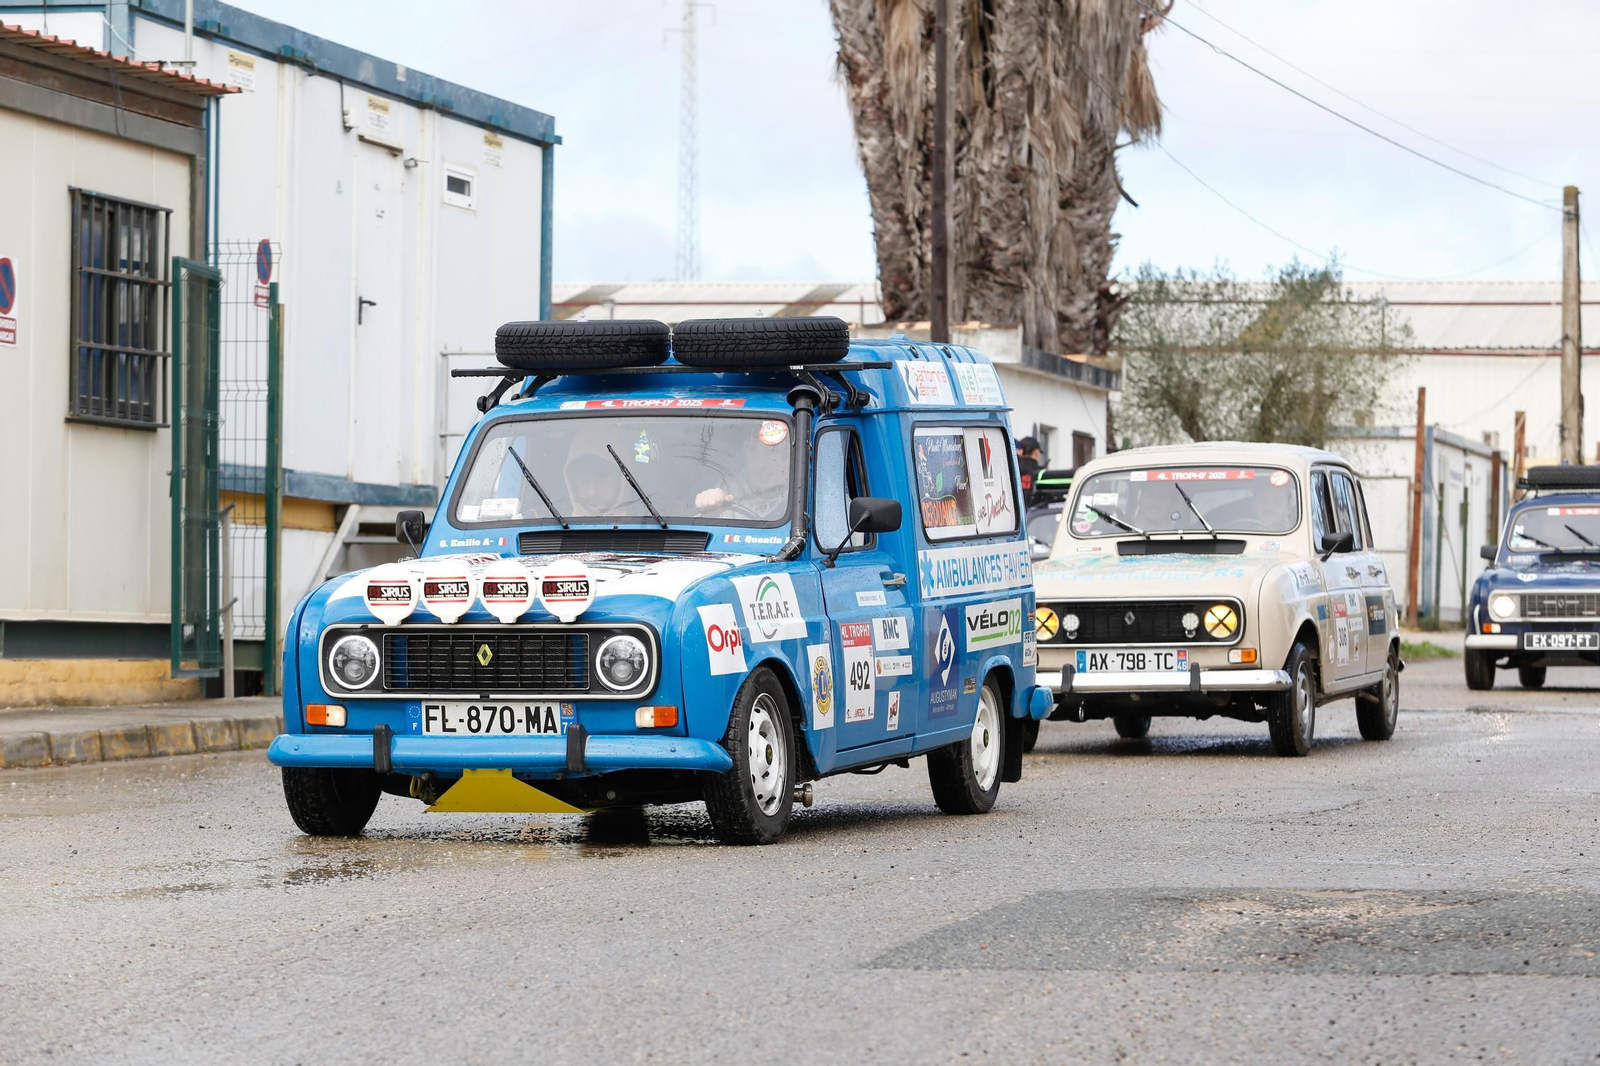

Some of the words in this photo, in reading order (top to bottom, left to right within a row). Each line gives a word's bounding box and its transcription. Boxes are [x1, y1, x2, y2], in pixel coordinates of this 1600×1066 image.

[601, 400, 617, 408] 4L
[622, 399, 674, 407] TROPHY
[676, 399, 703, 407] 2025
[1157, 472, 1168, 480] 4L
[1171, 472, 1206, 480] TROPHY
[450, 538, 480, 547] Emilio
[745, 535, 783, 544] Quentin
[937, 553, 1002, 589] AMBULANCES
[381, 586, 410, 597] SIRIUS
[438, 583, 467, 594] SIRIUS
[497, 583, 527, 594] SIRIUS
[557, 581, 587, 593] SIRIUS
[749, 601, 794, 621] T.E.R.A.F.
[849, 624, 870, 638] TROPHY
[882, 618, 900, 639] RMC
[707, 621, 742, 655] Orpi
[1089, 653, 1174, 670] AX-798-TC
[1177, 661, 1187, 670] 46
[850, 660, 870, 691] 492
[412, 723, 418, 731] F
[424, 704, 558, 734] FL-870-MA
